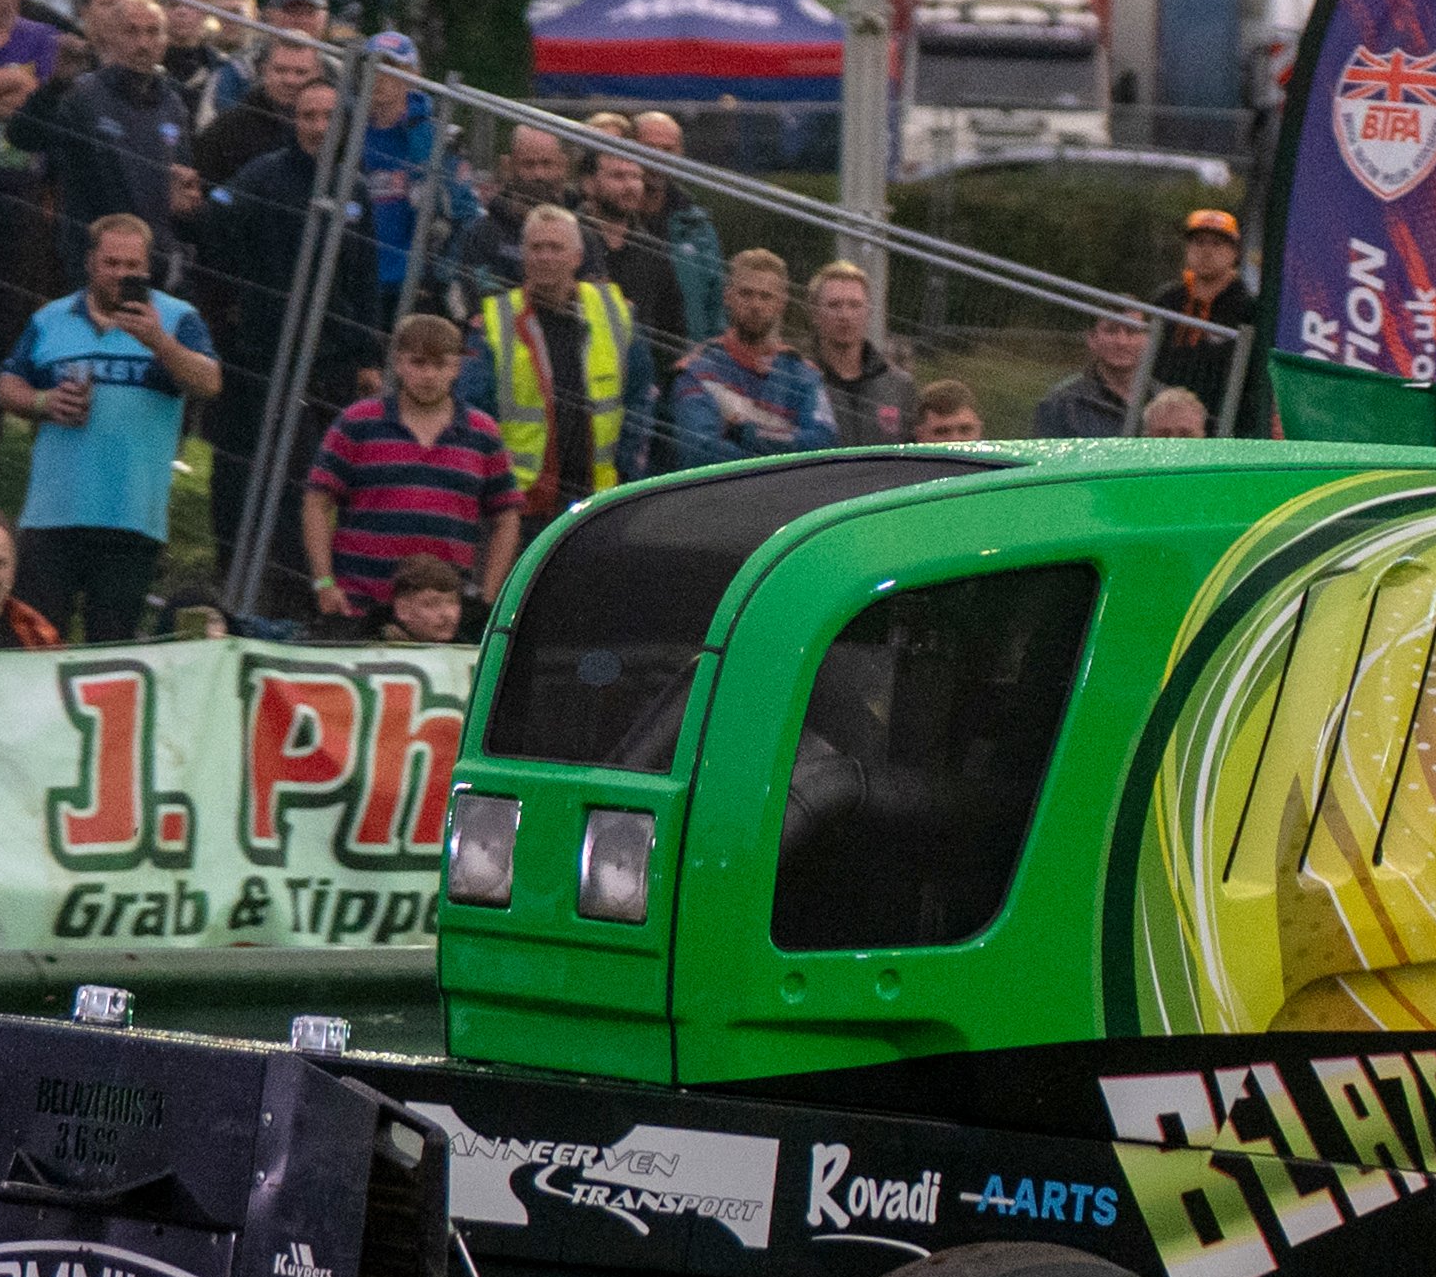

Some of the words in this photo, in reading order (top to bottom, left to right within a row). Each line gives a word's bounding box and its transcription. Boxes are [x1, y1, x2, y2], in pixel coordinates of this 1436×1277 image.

[1360, 104, 1421, 144] BTPA
[46, 660, 194, 872] J.
[237, 653, 470, 873] Ph
[54, 881, 211, 940] Grab
[231, 873, 273, 931] &
[449, 1130, 502, 1160] AN
[502, 1140, 681, 1179] NEERVEN
[572, 1182, 764, 1223] TRANSPORT
[806, 1141, 942, 1229] Rovadi
[976, 1173, 1119, 1227] AARTS
